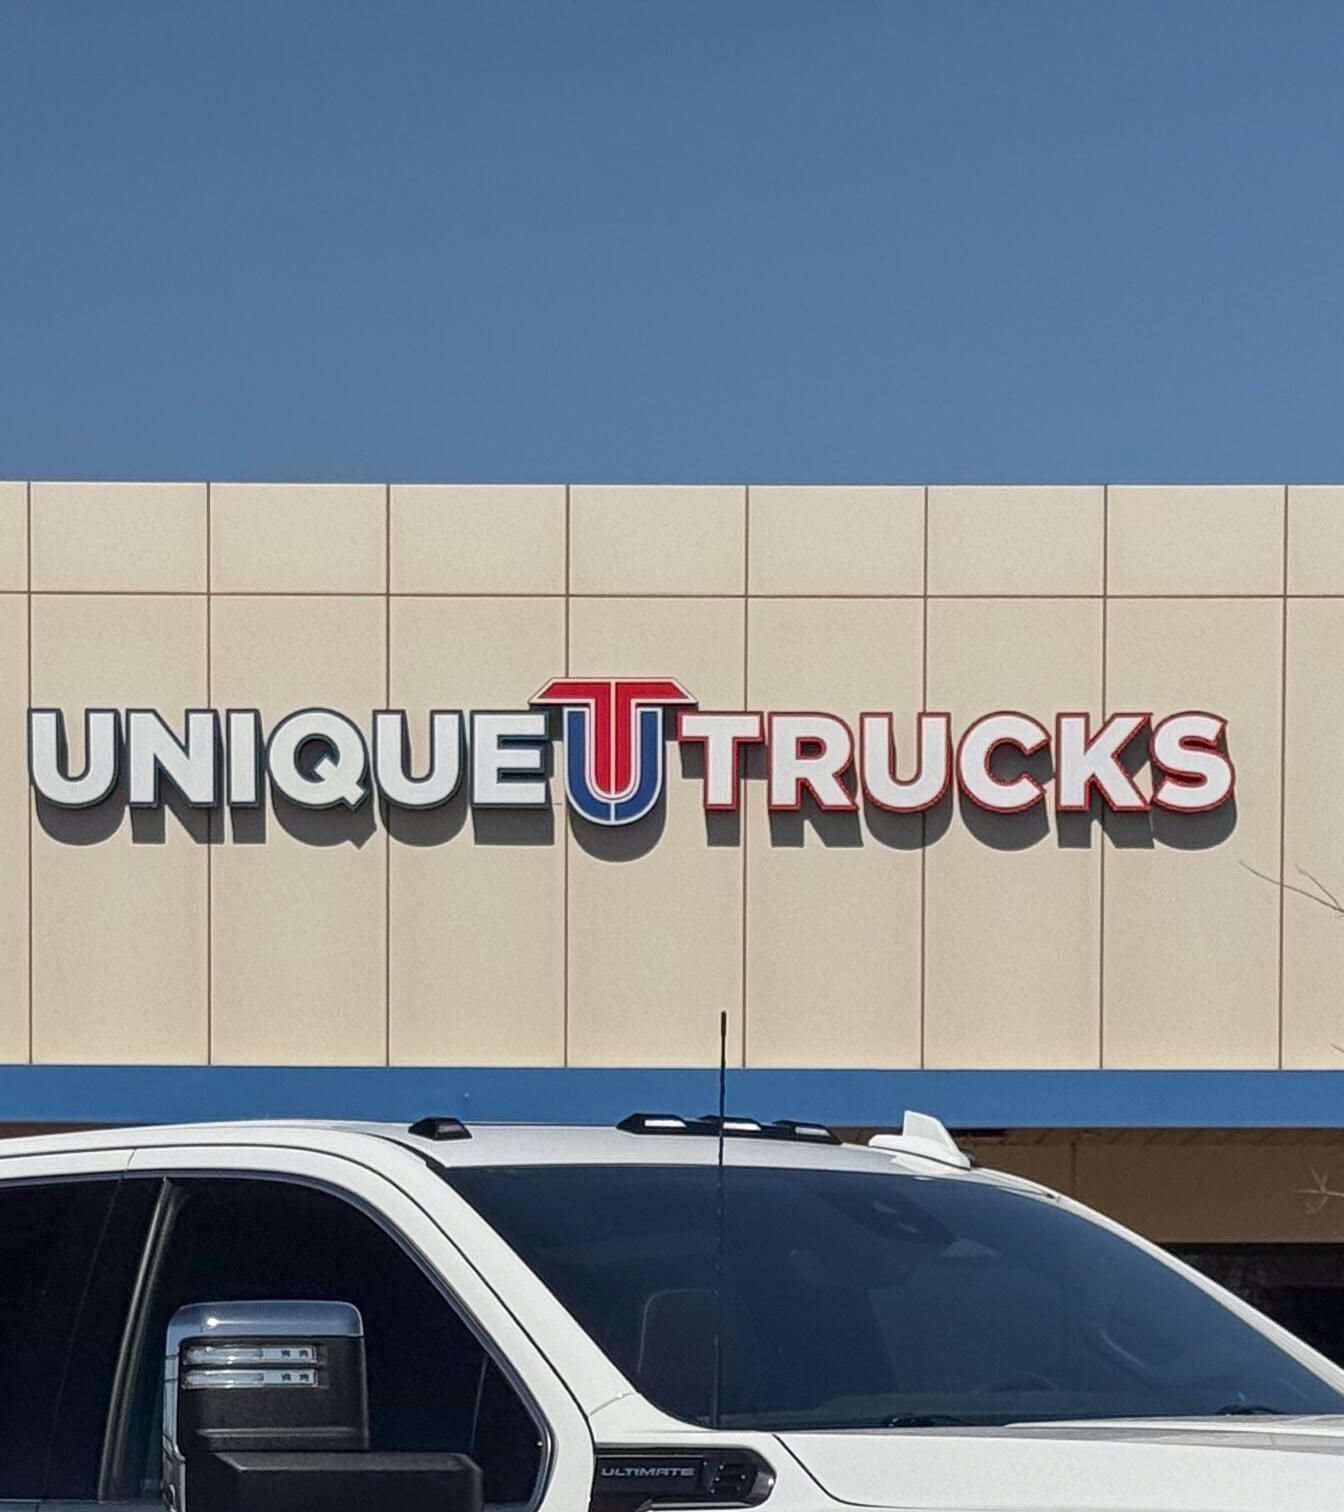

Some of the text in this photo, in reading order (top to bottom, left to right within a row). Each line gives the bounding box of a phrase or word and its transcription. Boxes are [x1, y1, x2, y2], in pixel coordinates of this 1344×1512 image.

[28, 707, 549, 814] UNIQUE
[677, 710, 1235, 812] TRUCKS
[601, 1466, 695, 1478] ULTIMATE
